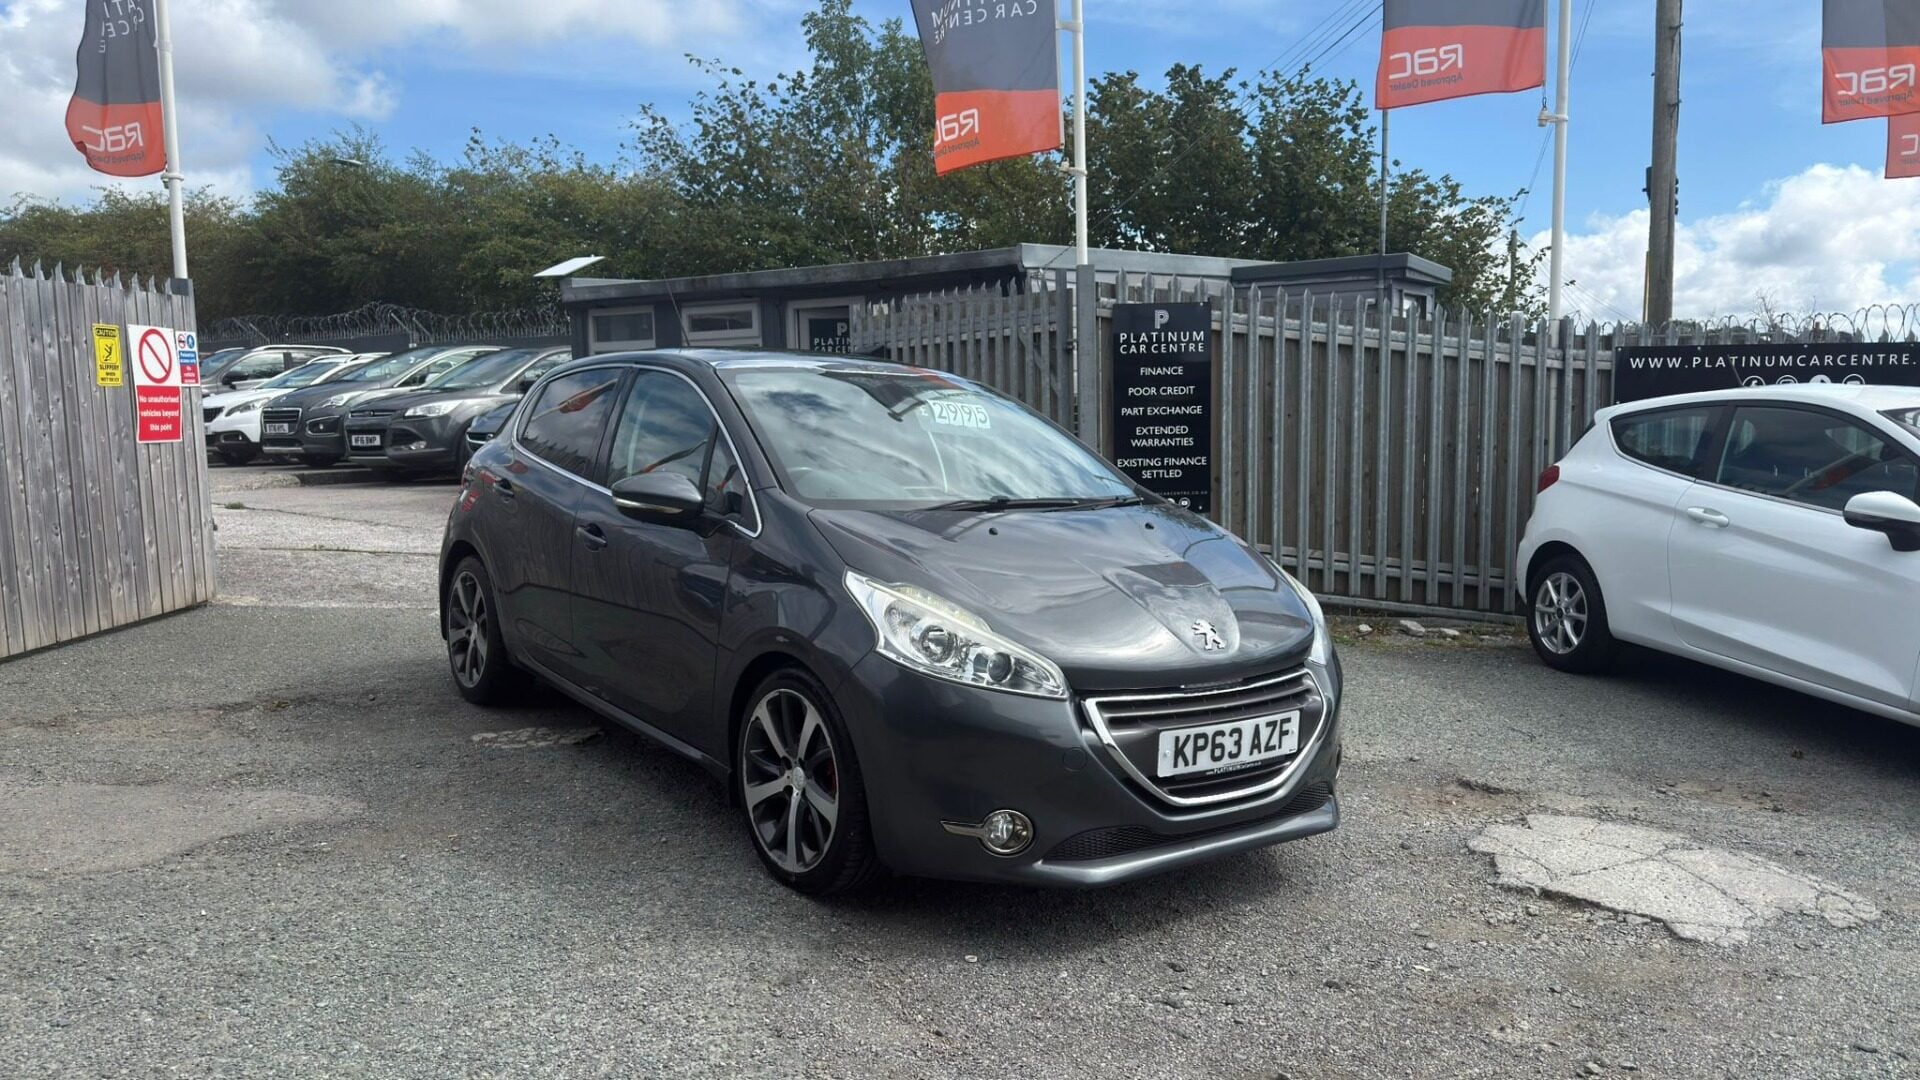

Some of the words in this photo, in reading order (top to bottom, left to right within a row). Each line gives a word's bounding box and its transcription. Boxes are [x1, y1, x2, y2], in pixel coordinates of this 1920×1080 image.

[1120, 330, 1204, 343] PLATINUM
[1120, 343, 1147, 354] CAR
[1151, 342, 1204, 353] CENTRE
[1140, 366, 1184, 376] FINANCE
[1128, 387, 1157, 396] POOR
[1160, 385, 1195, 395] CREDIT
[162, 409, 179, 419] beyond
[1121, 407, 1144, 416] PART
[1147, 405, 1202, 416] EXCHANGE
[1136, 425, 1188, 436] EXTENDED
[1131, 437, 1194, 447] WARRANTIES
[1117, 457, 1161, 468] EXISTING
[1164, 456, 1207, 466] FINANCE
[1142, 469, 1182, 479] SETTLED
[1173, 727, 1243, 769] KP63
[1249, 717, 1292, 756] AZF
